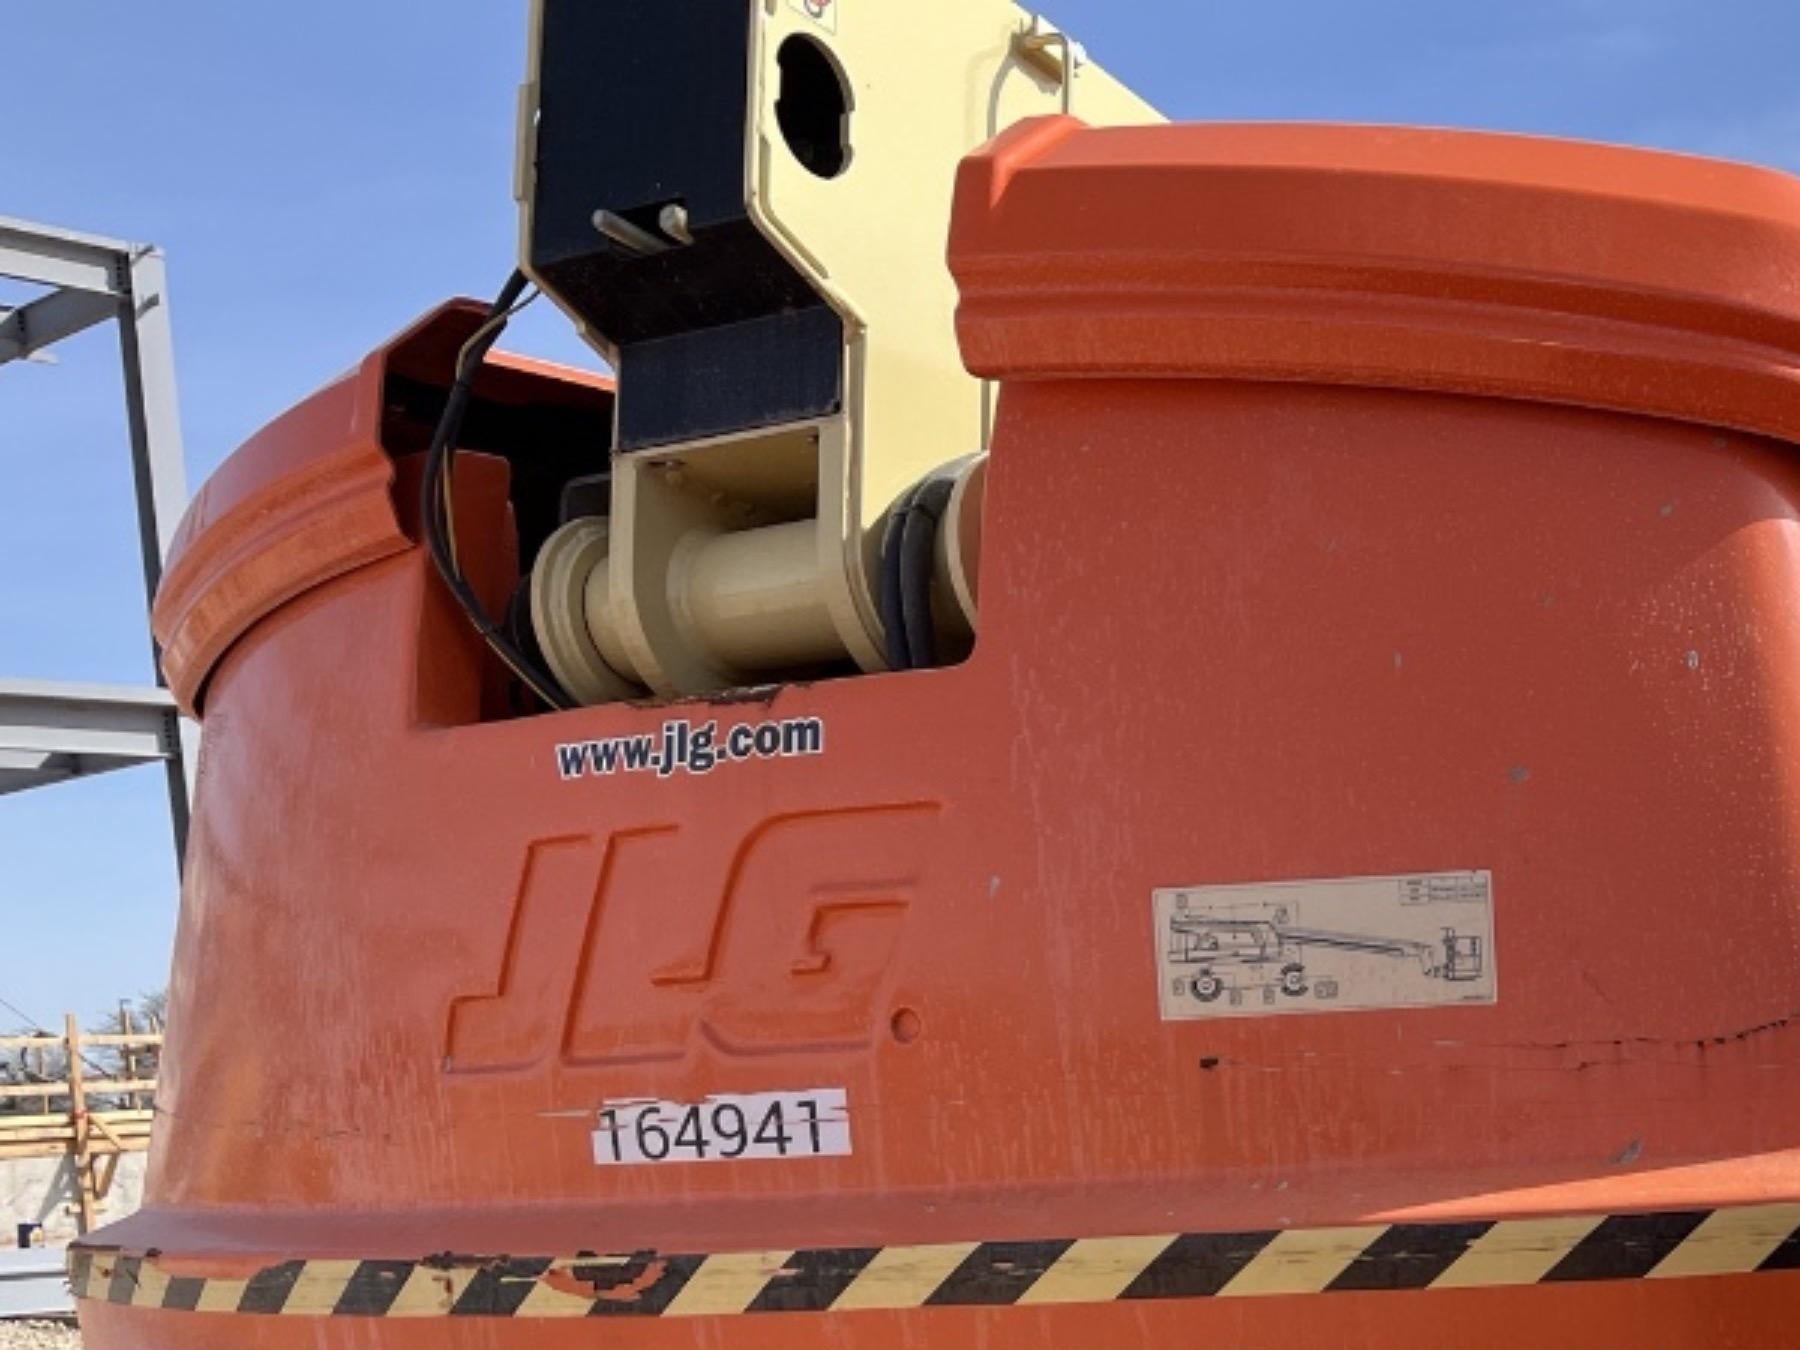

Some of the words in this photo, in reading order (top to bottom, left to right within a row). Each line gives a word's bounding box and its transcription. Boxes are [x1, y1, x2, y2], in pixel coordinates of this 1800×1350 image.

[556, 716, 823, 779] www.jlg.com
[445, 800, 942, 1073] JLG
[598, 1100, 823, 1163] 164941
